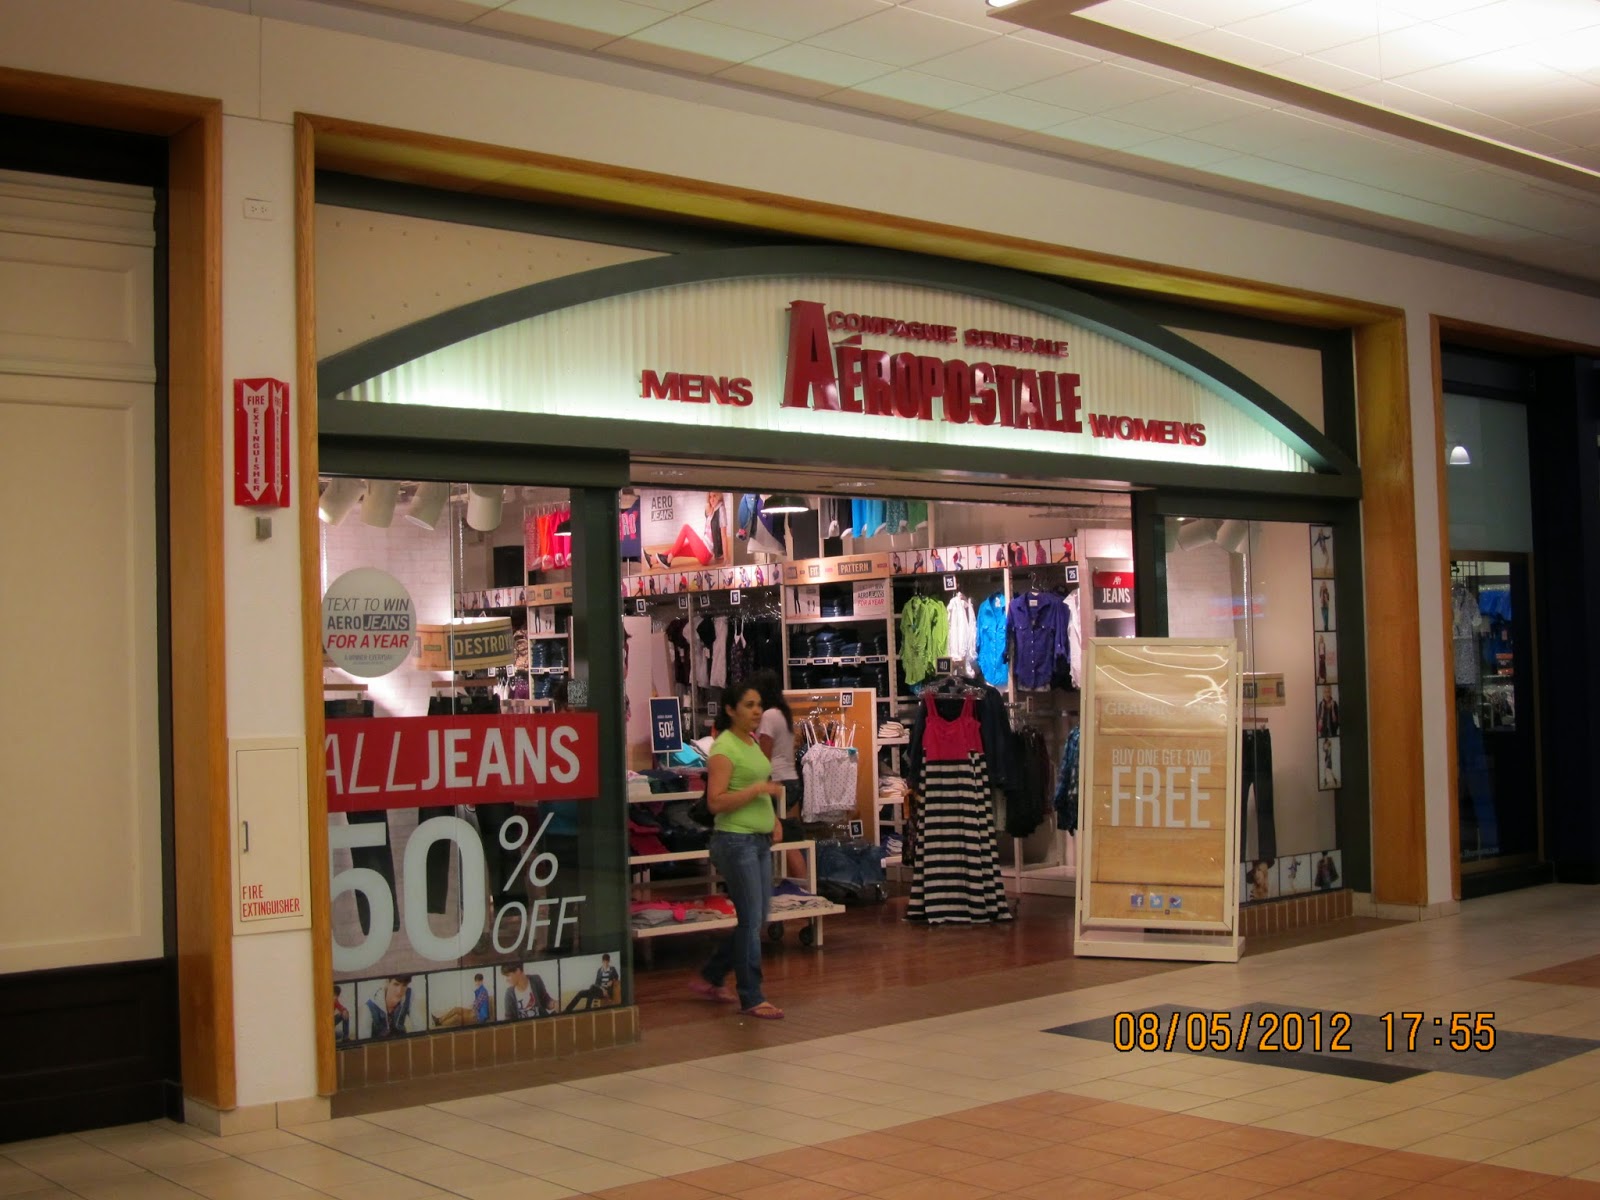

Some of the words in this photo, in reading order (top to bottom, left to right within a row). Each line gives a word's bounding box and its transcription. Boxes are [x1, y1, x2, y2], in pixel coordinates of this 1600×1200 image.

[827, 310, 957, 343] COMPAGNIE
[964, 328, 1069, 357] GENERALE
[640, 369, 752, 407] MENS
[247, 395, 265, 406] FIRE
[1089, 413, 1206, 446] WOMENS
[252, 407, 260, 491] EXTINGUISHER
[651, 495, 673, 509] AERO
[652, 510, 673, 520] JEANS
[840, 562, 869, 574] PATTERN
[1103, 588, 1131, 603] JEANS
[327, 597, 359, 611] TEXT
[363, 598, 380, 611] TO
[384, 598, 410, 611] WIN
[327, 616, 361, 630] AERO
[364, 615, 408, 630] JEANS
[327, 634, 357, 649] FOR
[360, 634, 370, 648] A
[373, 634, 409, 648] YEAR
[325, 731, 417, 795] ALL
[420, 725, 581, 791] JEANS
[1112, 749, 1134, 765] BUY
[1137, 749, 1159, 765] ONE
[1162, 749, 1182, 765] GET
[1187, 749, 1211, 765] TWO
[1111, 766, 1211, 828] FREE
[242, 885, 264, 900] FIRE
[242, 898, 300, 917] EXTINGUISHER
[492, 896, 586, 954] OFF
